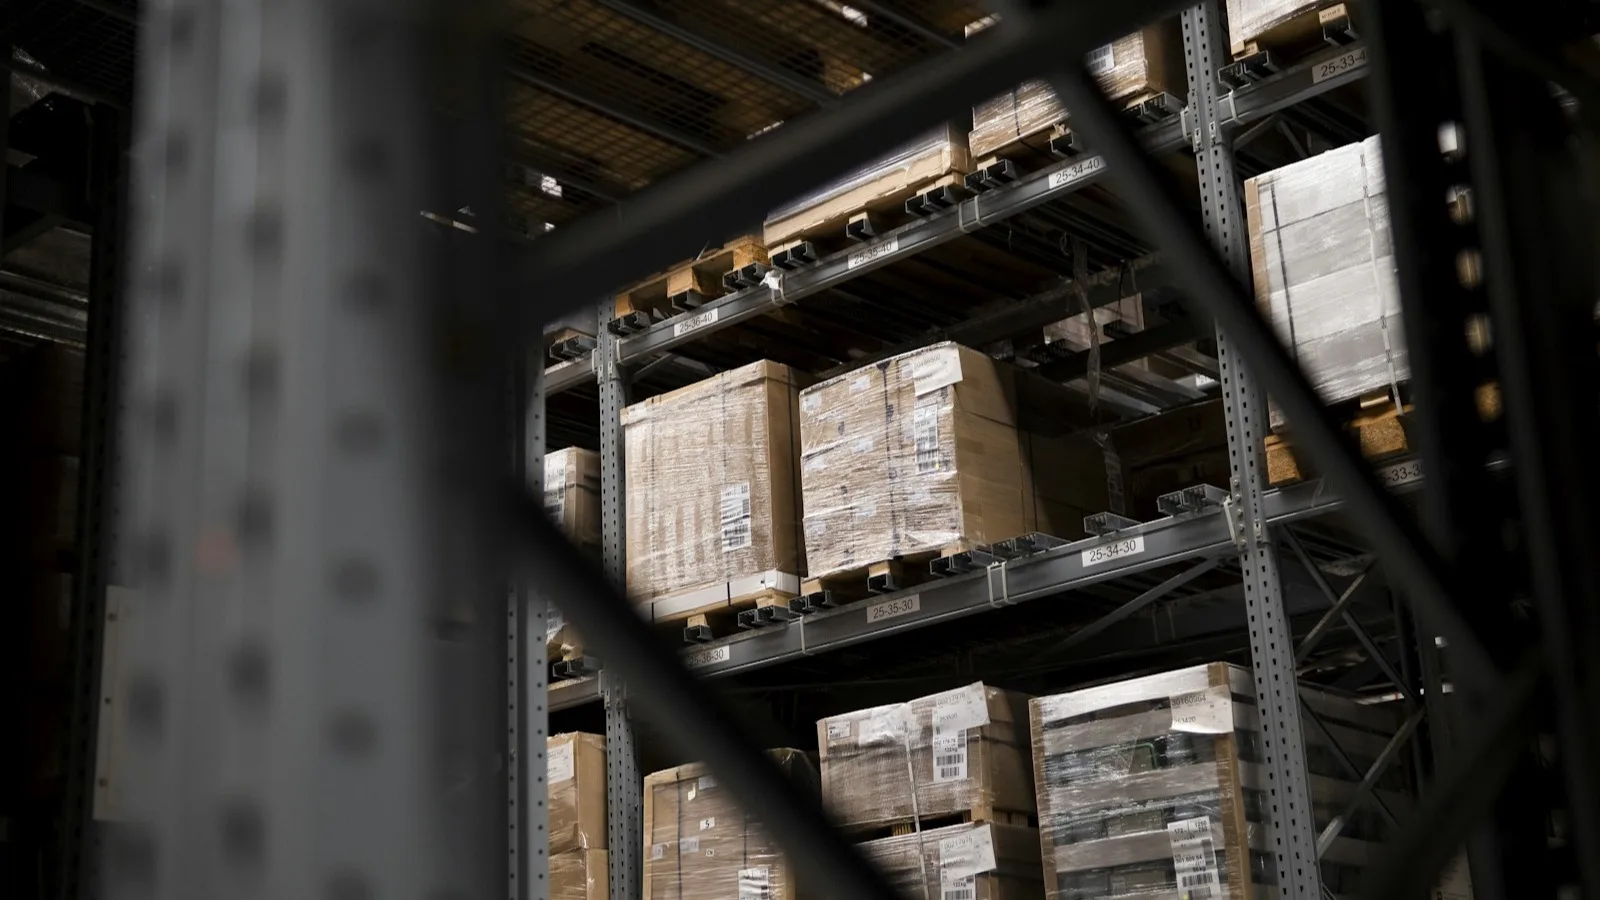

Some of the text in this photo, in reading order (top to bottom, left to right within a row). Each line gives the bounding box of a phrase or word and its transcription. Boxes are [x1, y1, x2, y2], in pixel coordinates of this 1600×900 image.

[1321, 49, 1367, 77] 25-33-4
[1056, 157, 1100, 184] 25-34-40
[854, 241, 892, 264] 25-35-40
[680, 312, 712, 333] 25-36-40
[1090, 539, 1136, 562] 25-34-30
[873, 599, 913, 619] 25-35-30
